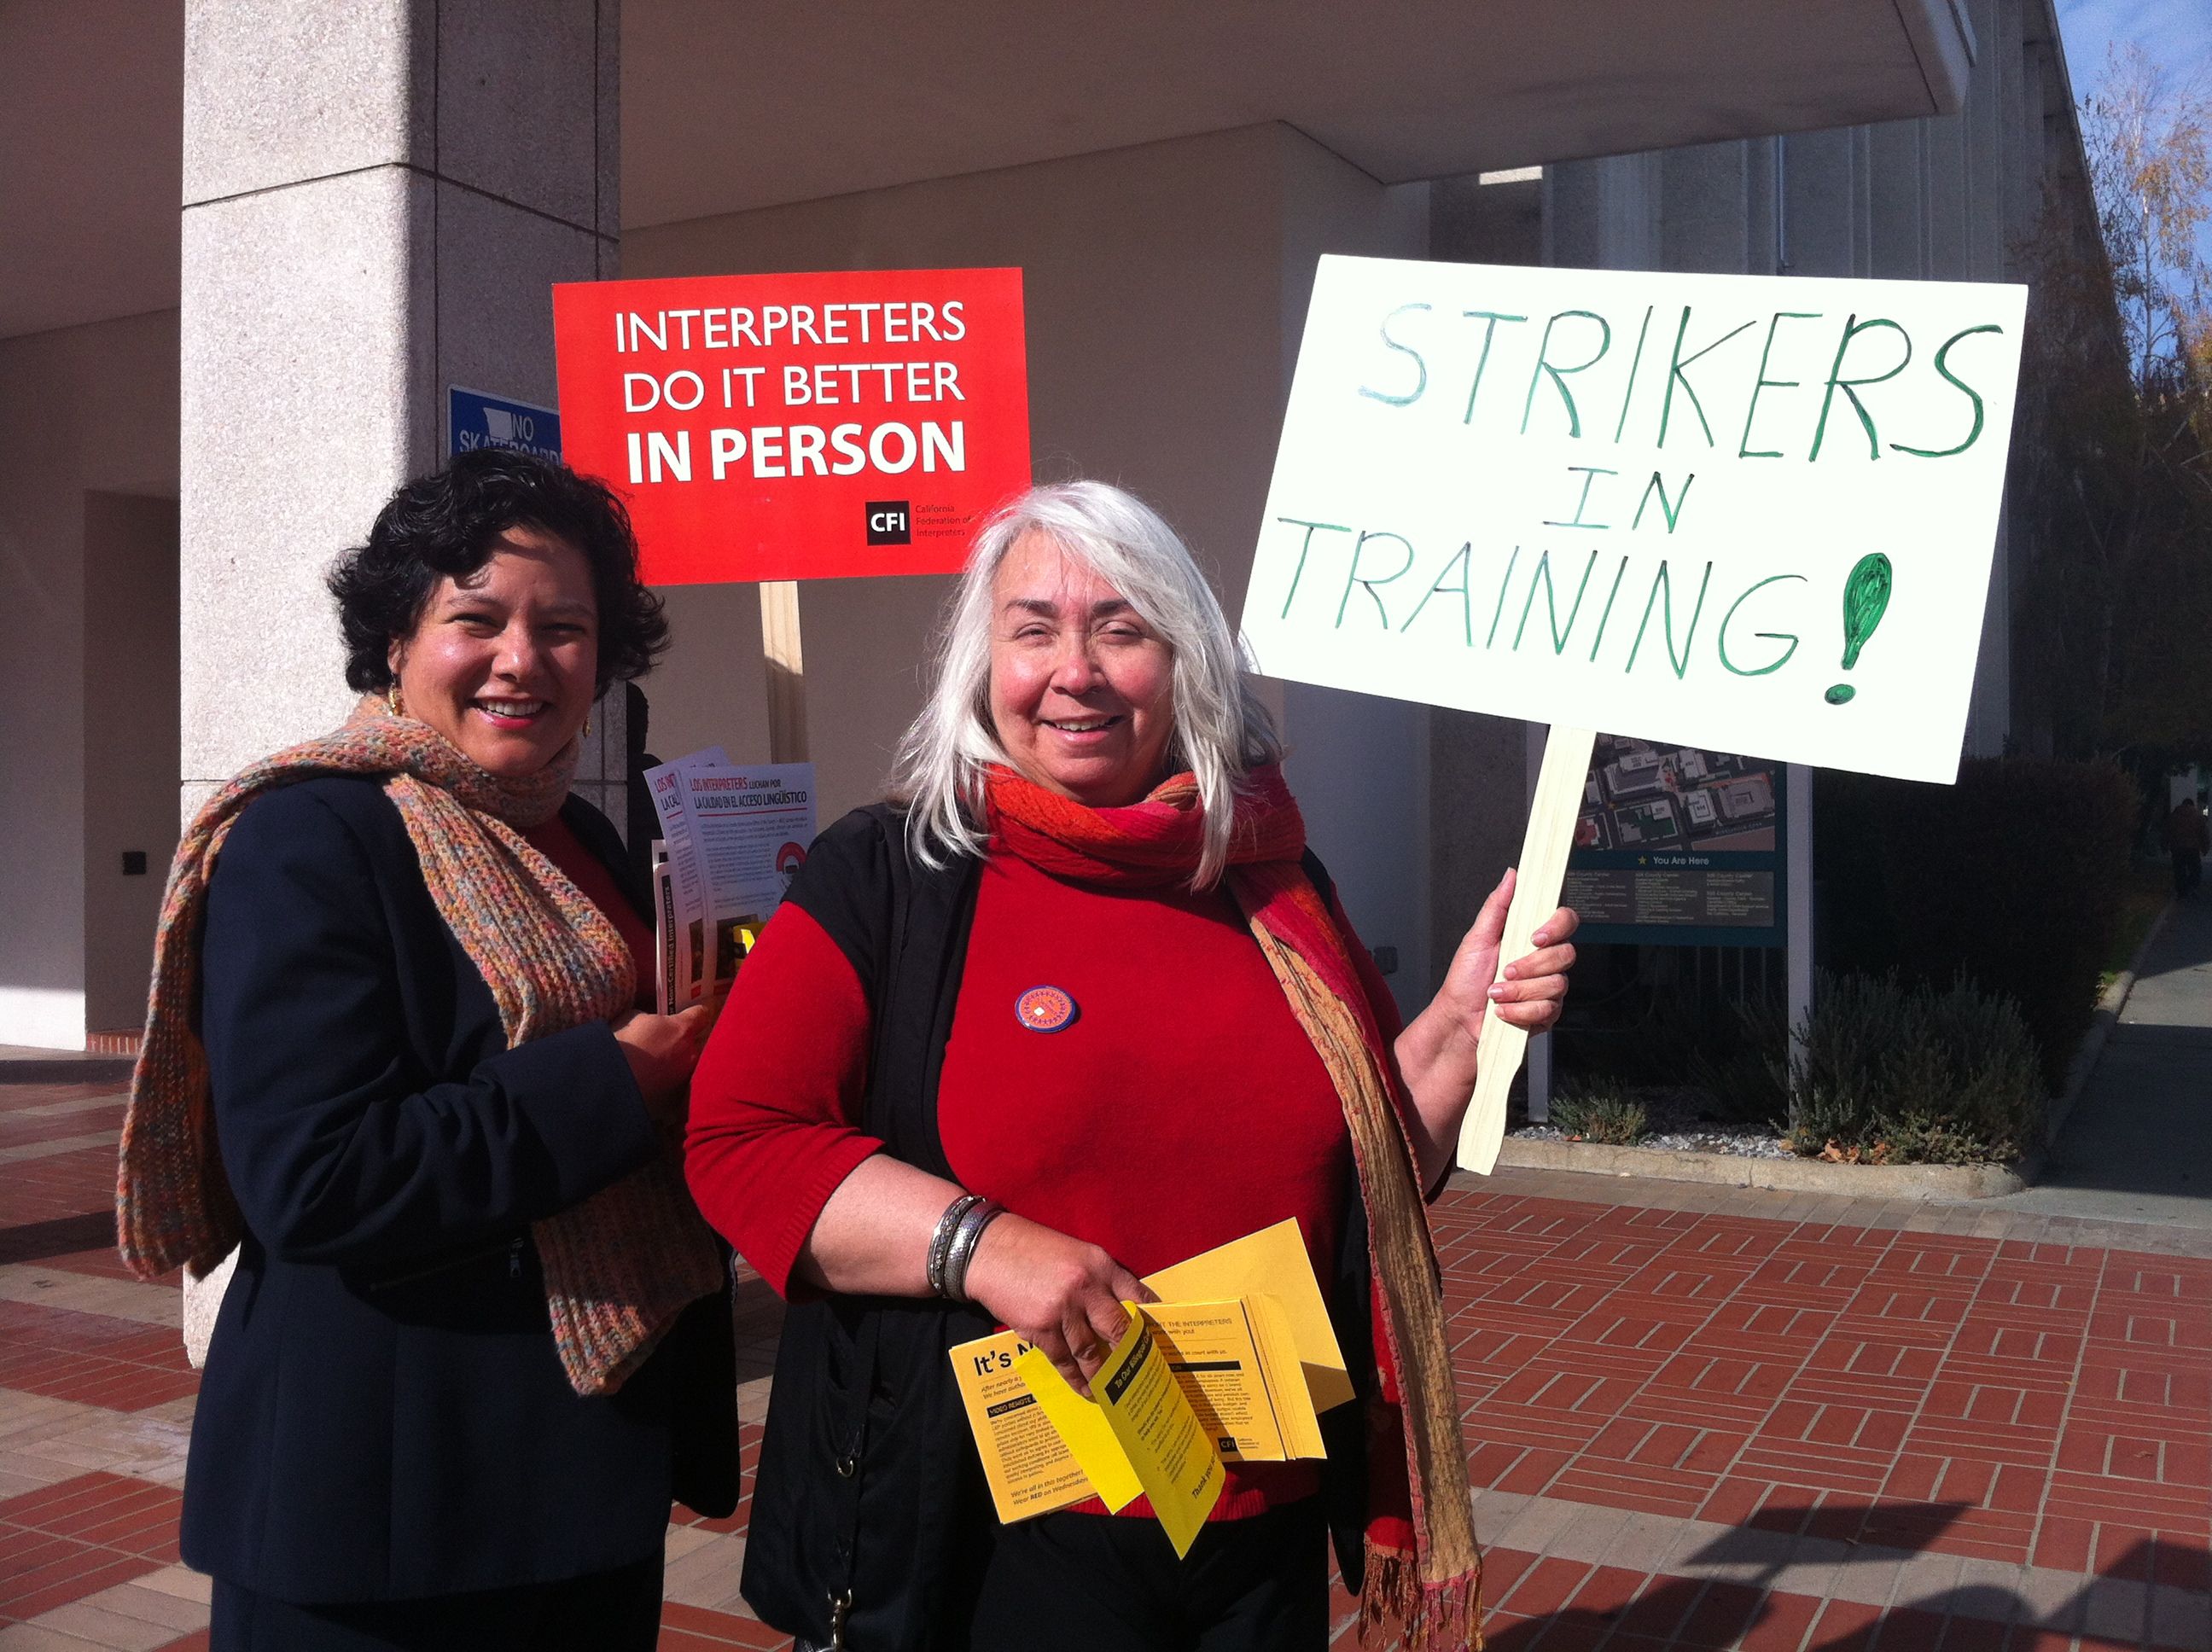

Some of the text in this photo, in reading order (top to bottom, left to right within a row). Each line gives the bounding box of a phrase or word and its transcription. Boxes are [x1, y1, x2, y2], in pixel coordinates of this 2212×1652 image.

[614, 300, 966, 353] INTERPRETERS
[623, 361, 966, 413] DO IT BETTER
[1359, 303, 2004, 462] STRIKERS
[513, 414, 534, 441] NO
[627, 420, 966, 484] IN PERSON
[1540, 466, 1696, 535] IN
[870, 513, 905, 532] CFI
[916, 515, 971, 525] Federation of
[917, 529, 965, 538] Interpreters
[1277, 517, 1894, 707] TRAINING!
[690, 777, 781, 791] LOS INTERPRETERS LUCHAN POR
[694, 797, 702, 809] LA
[739, 794, 762, 807] ACCESO
[1653, 856, 1709, 865] You Are Here
[1183, 1318, 1232, 1327] INTERPRETERS
[974, 1350, 1011, 1376] It's
[990, 1403, 1008, 1414] VIDEO
[1220, 1440, 1236, 1449] CFI
[1030, 1492, 1043, 1500] RED
[1191, 1475, 1207, 1499] Thank
